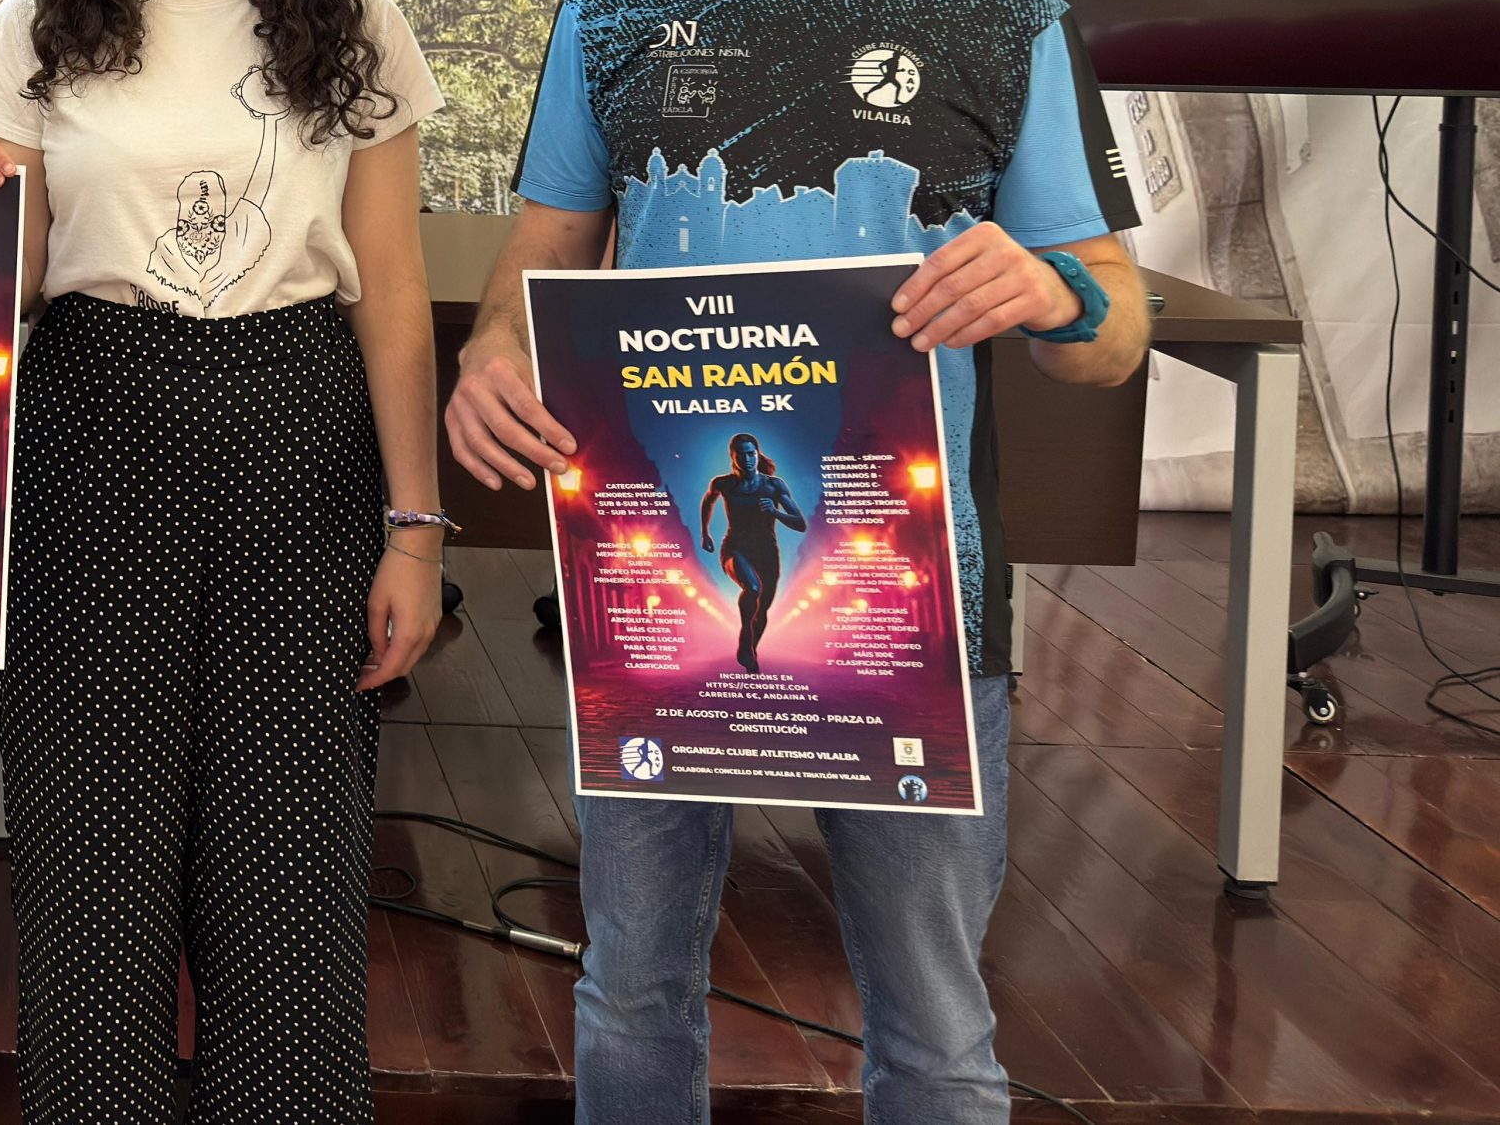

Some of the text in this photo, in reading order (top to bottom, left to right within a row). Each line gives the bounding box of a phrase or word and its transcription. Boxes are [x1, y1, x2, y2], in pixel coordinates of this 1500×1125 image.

[851, 42, 924, 67] CLUBE ATLETISMO
[852, 109, 911, 125] VILALBA
[685, 295, 734, 315] VIII
[618, 323, 819, 352] NOCTURNA
[621, 356, 837, 388] SAN RAMÓN
[651, 394, 794, 414] VILALBA 5K
[655, 708, 883, 724] 22 DE AGOSTO DENDE AS 20:00 PRAZA DA
[728, 723, 807, 734] CONSTITUCIÓN
[671, 745, 860, 761] ORGANIZA: CLUBE ATLETISMO VILALBA
